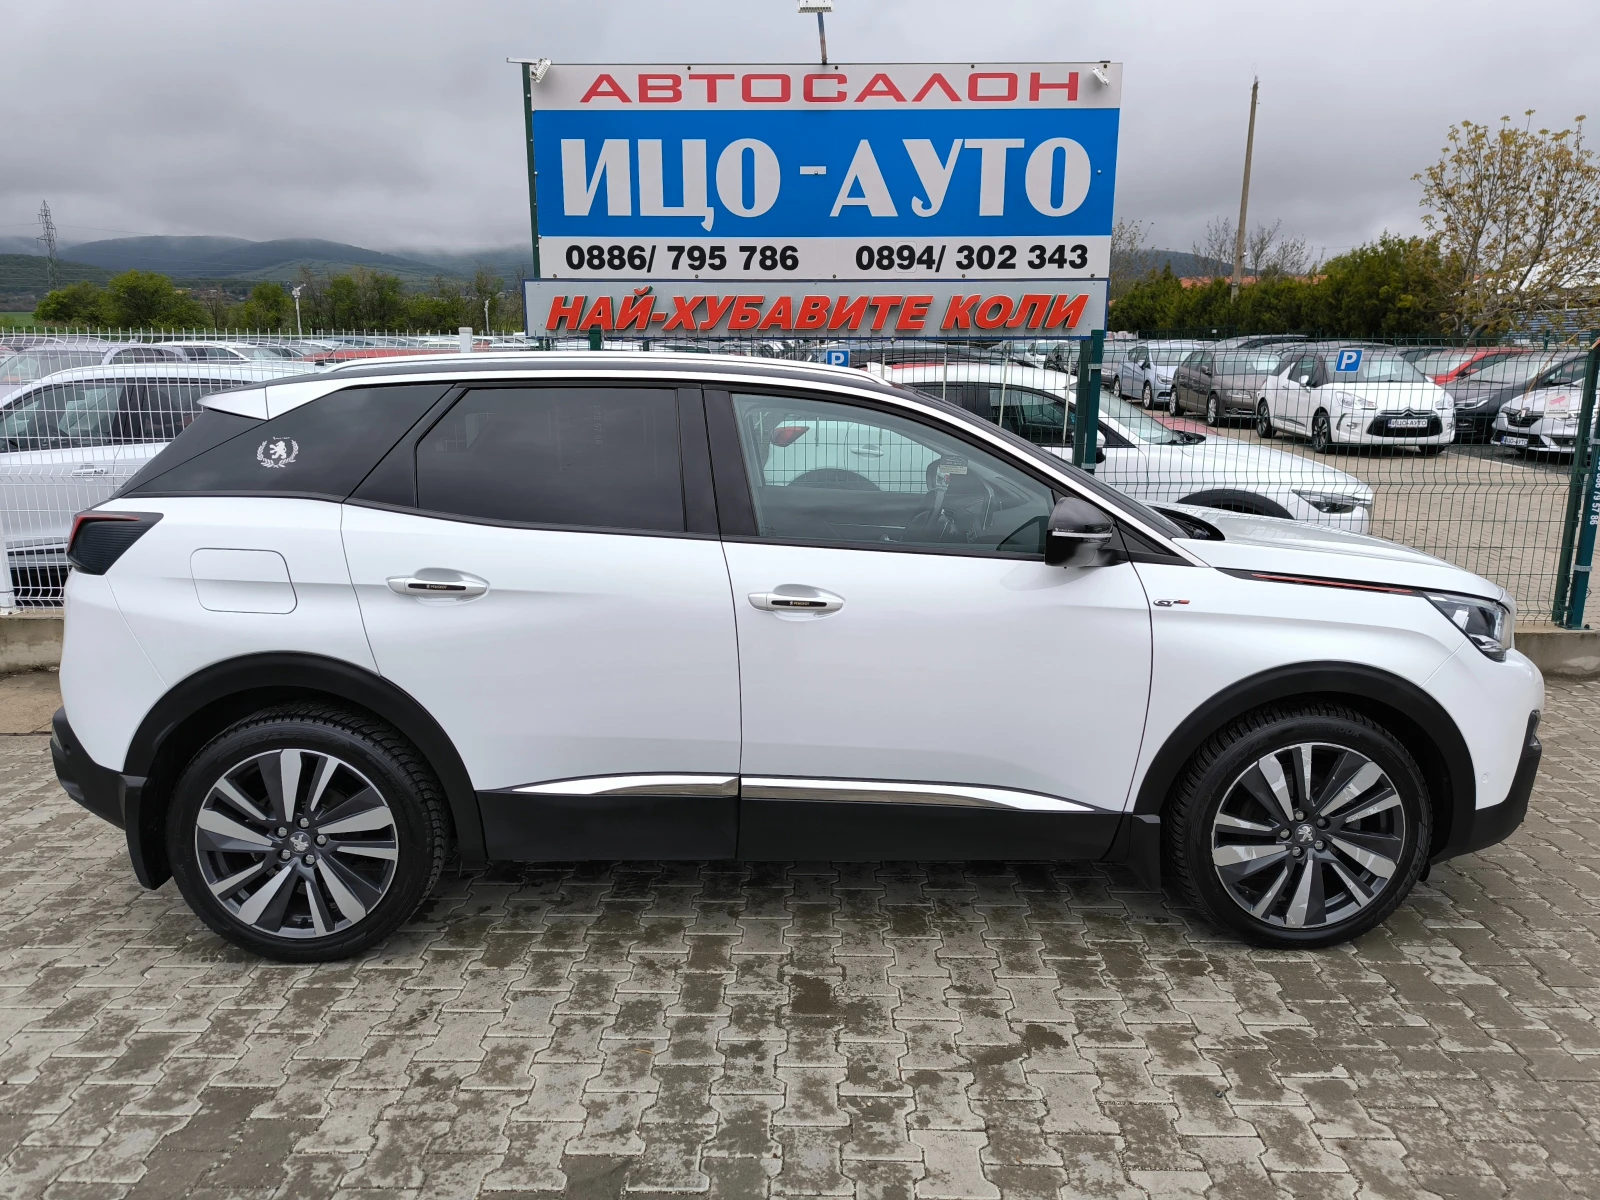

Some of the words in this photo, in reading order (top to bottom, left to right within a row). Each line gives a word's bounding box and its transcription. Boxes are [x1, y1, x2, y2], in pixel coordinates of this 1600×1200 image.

[580, 72, 1079, 104] АВТОСАЛОН
[560, 138, 781, 232] ИЦО
[565, 244, 657, 273] 0886/
[667, 245, 727, 271] 795
[739, 245, 799, 271] 786
[855, 244, 947, 273] 0894/
[955, 244, 1017, 270] 302
[1027, 244, 1088, 270] 343
[545, 286, 934, 331] НАЙ-ХУБАВИТЕ
[942, 293, 1090, 331] КОЛИ
[831, 352, 845, 366] P
[1340, 351, 1357, 370] P
[1590, 515, 1598, 525] 86
